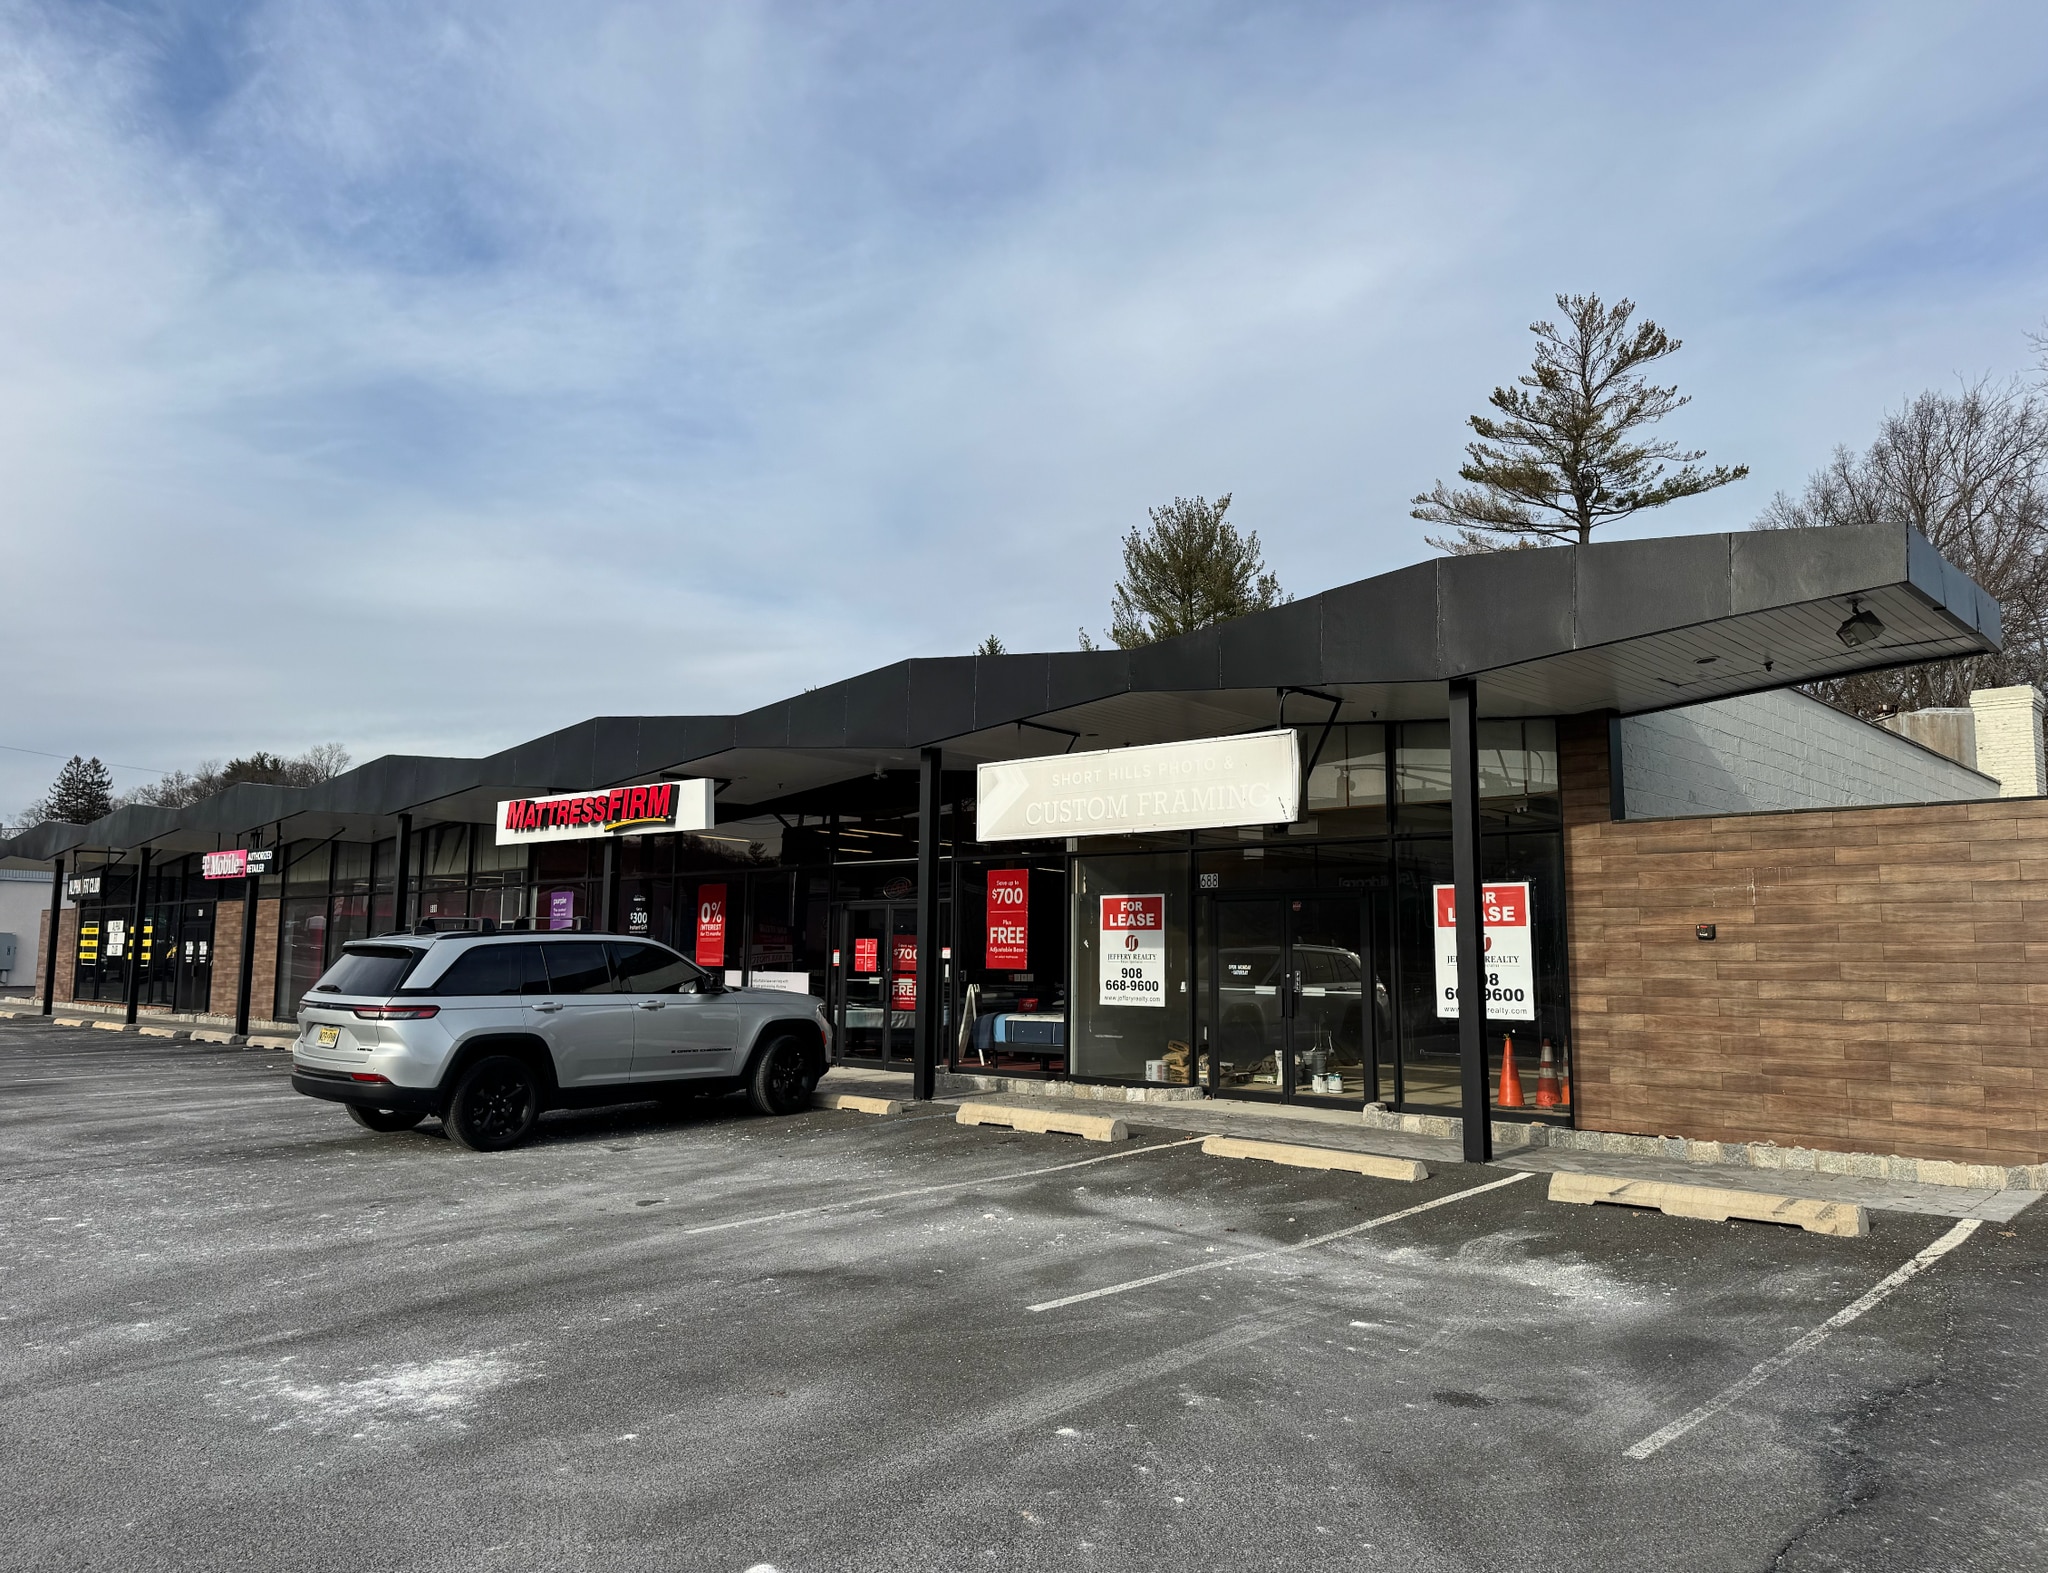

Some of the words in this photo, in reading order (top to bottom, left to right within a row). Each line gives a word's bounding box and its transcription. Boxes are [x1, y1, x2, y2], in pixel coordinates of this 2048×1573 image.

[1052, 769, 1100, 787] SHORT
[1108, 765, 1152, 782] HILLS
[1158, 758, 1216, 776] PHOTO
[1223, 755, 1235, 770] &
[1025, 797, 1130, 826] CUSTOM
[1136, 781, 1271, 817] FRAMING
[247, 851, 272, 861] AUTHORIZED
[247, 863, 265, 874] RETAILER
[1200, 874, 1218, 888] 688
[991, 888, 1023, 905] $700
[701, 901, 722, 924] 0%
[1120, 901, 1143, 911] FOR
[630, 911, 648, 924] $300
[1109, 913, 1155, 926] LEASE
[1447, 905, 1516, 922] LSE
[699, 923, 722, 931] INTEREST
[990, 926, 1025, 944] FREE
[989, 946, 1013, 954] Adjustable
[1107, 953, 1132, 961] JEFFERY
[1132, 953, 1157, 961] REALTY
[1484, 955, 1520, 964] REALTY
[1121, 968, 1143, 979] 908
[1105, 979, 1159, 992] 668-9600
[1445, 987, 1525, 1002] 69600
